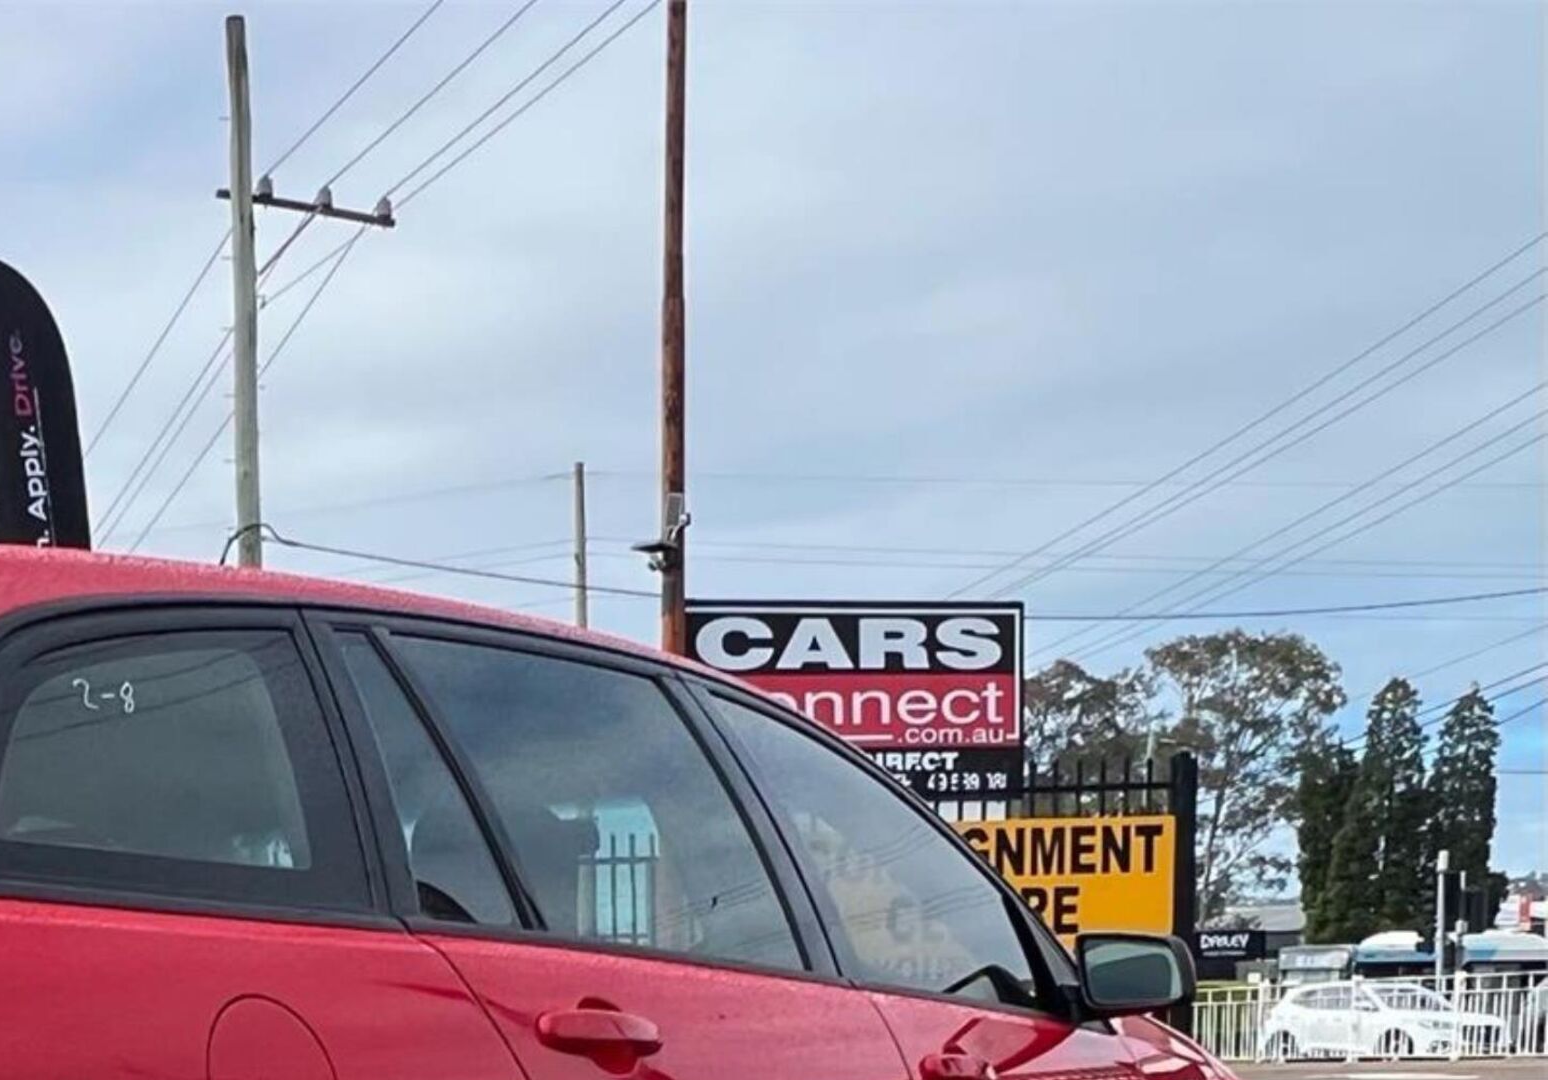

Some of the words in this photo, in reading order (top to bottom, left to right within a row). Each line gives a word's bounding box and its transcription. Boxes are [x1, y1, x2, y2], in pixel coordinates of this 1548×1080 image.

[20, 424, 49, 522] Apply.
[695, 615, 1003, 672] CARS
[897, 726, 1004, 746] .com.au
